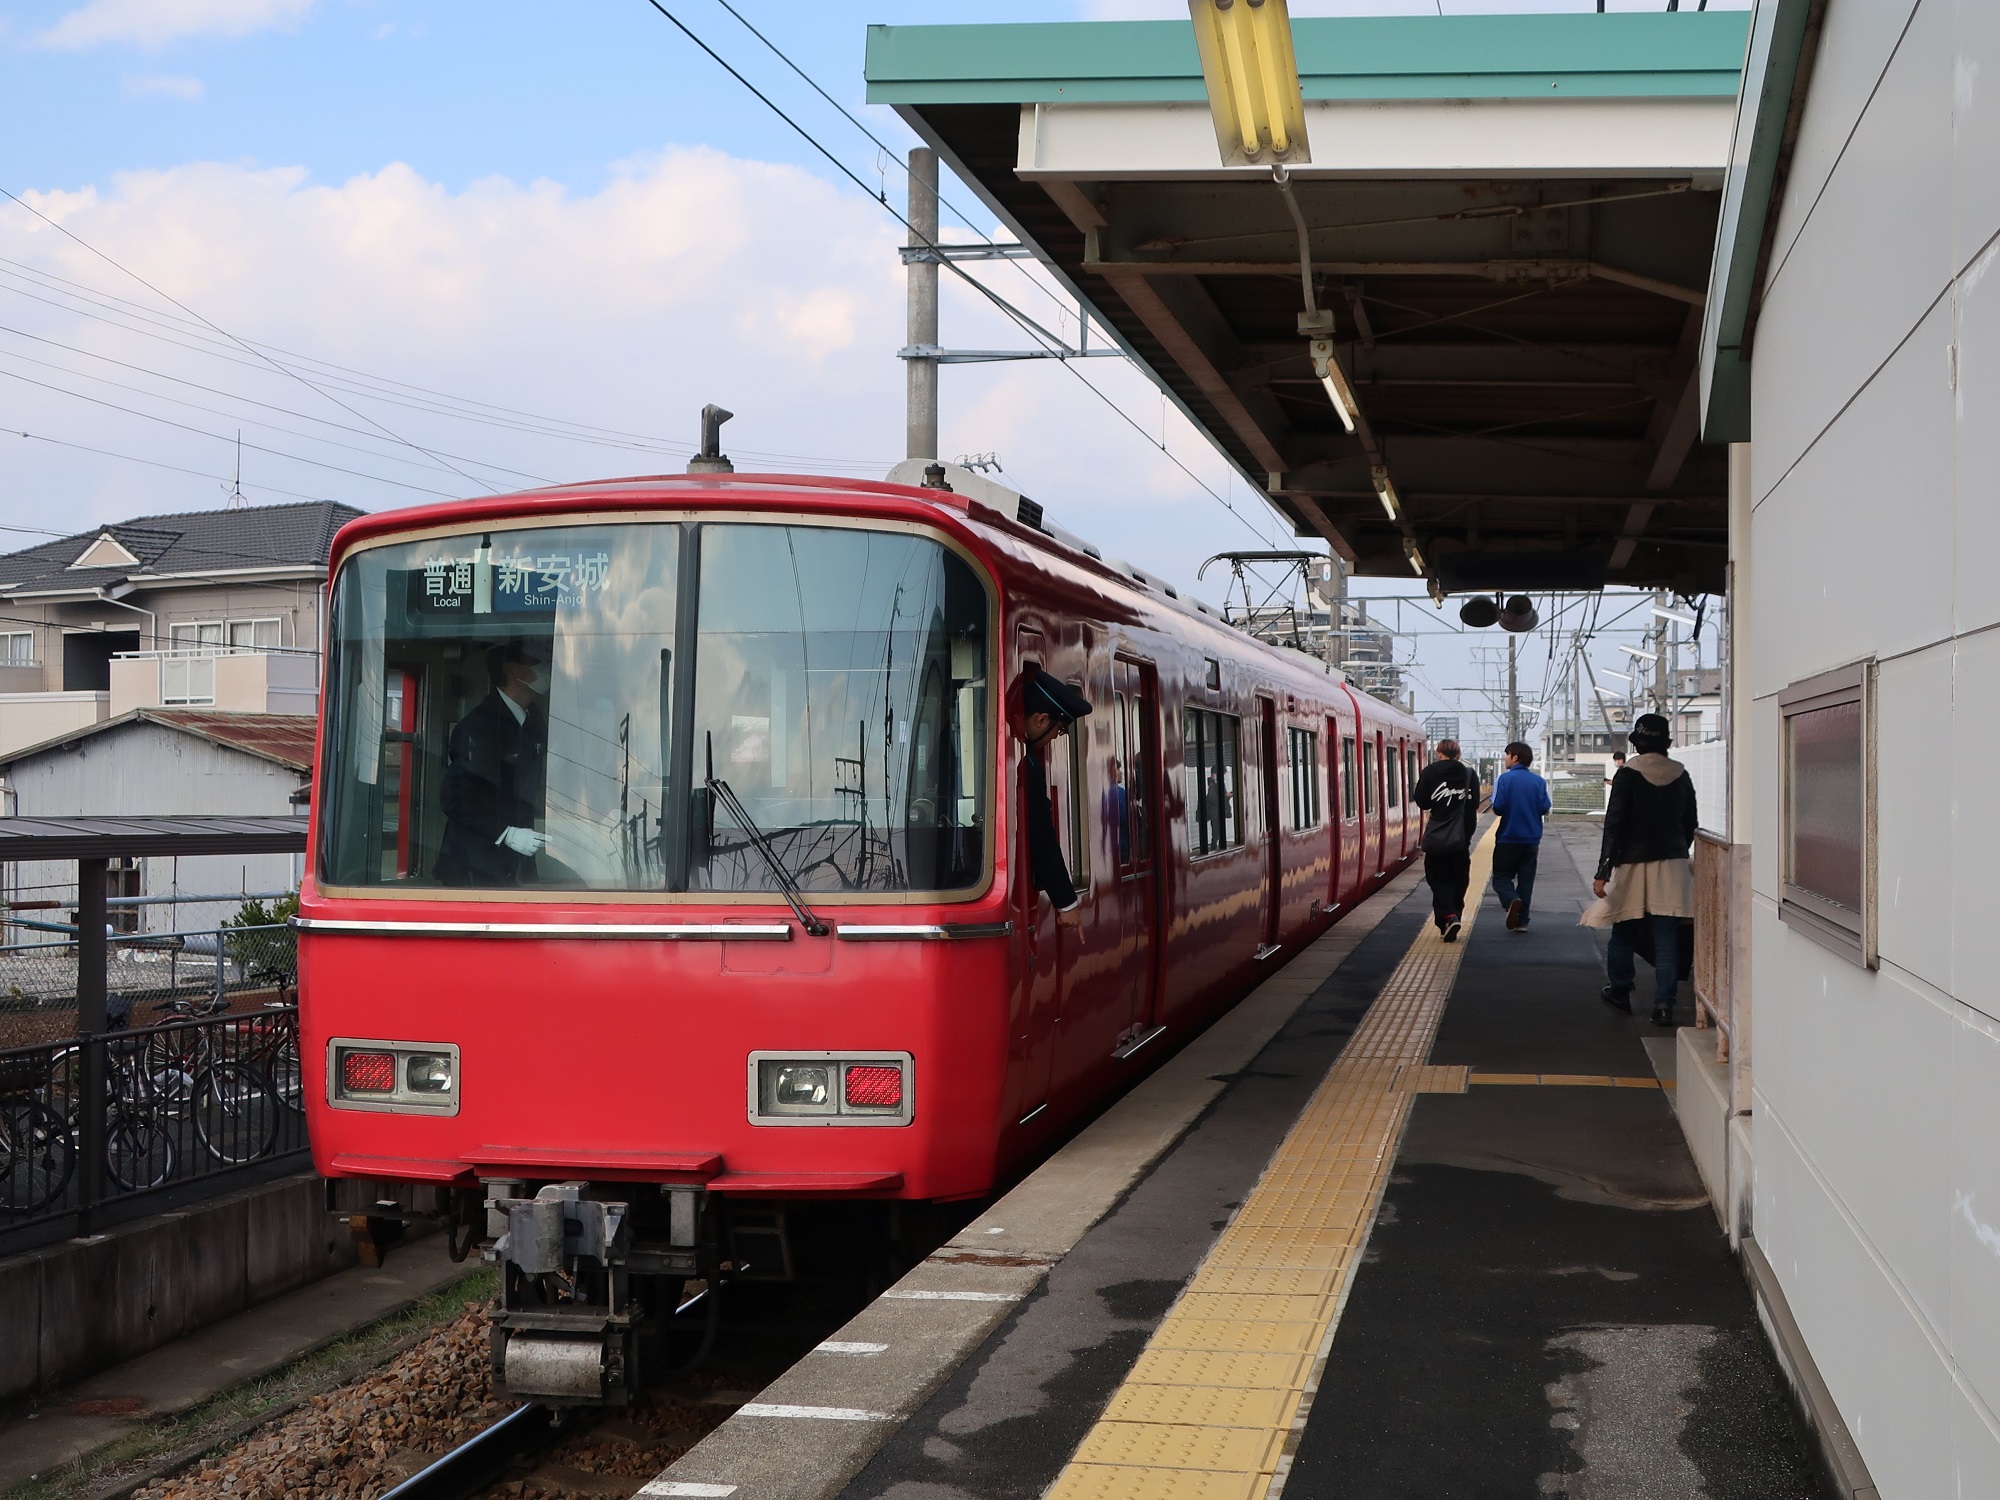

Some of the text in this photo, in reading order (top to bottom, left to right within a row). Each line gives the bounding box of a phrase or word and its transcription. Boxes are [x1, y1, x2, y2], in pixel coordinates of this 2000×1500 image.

[424, 557, 471, 595] 普通
[498, 552, 610, 594] 新安城
[433, 596, 461, 607] Local
[524, 594, 583, 607] Shin-Anjo
